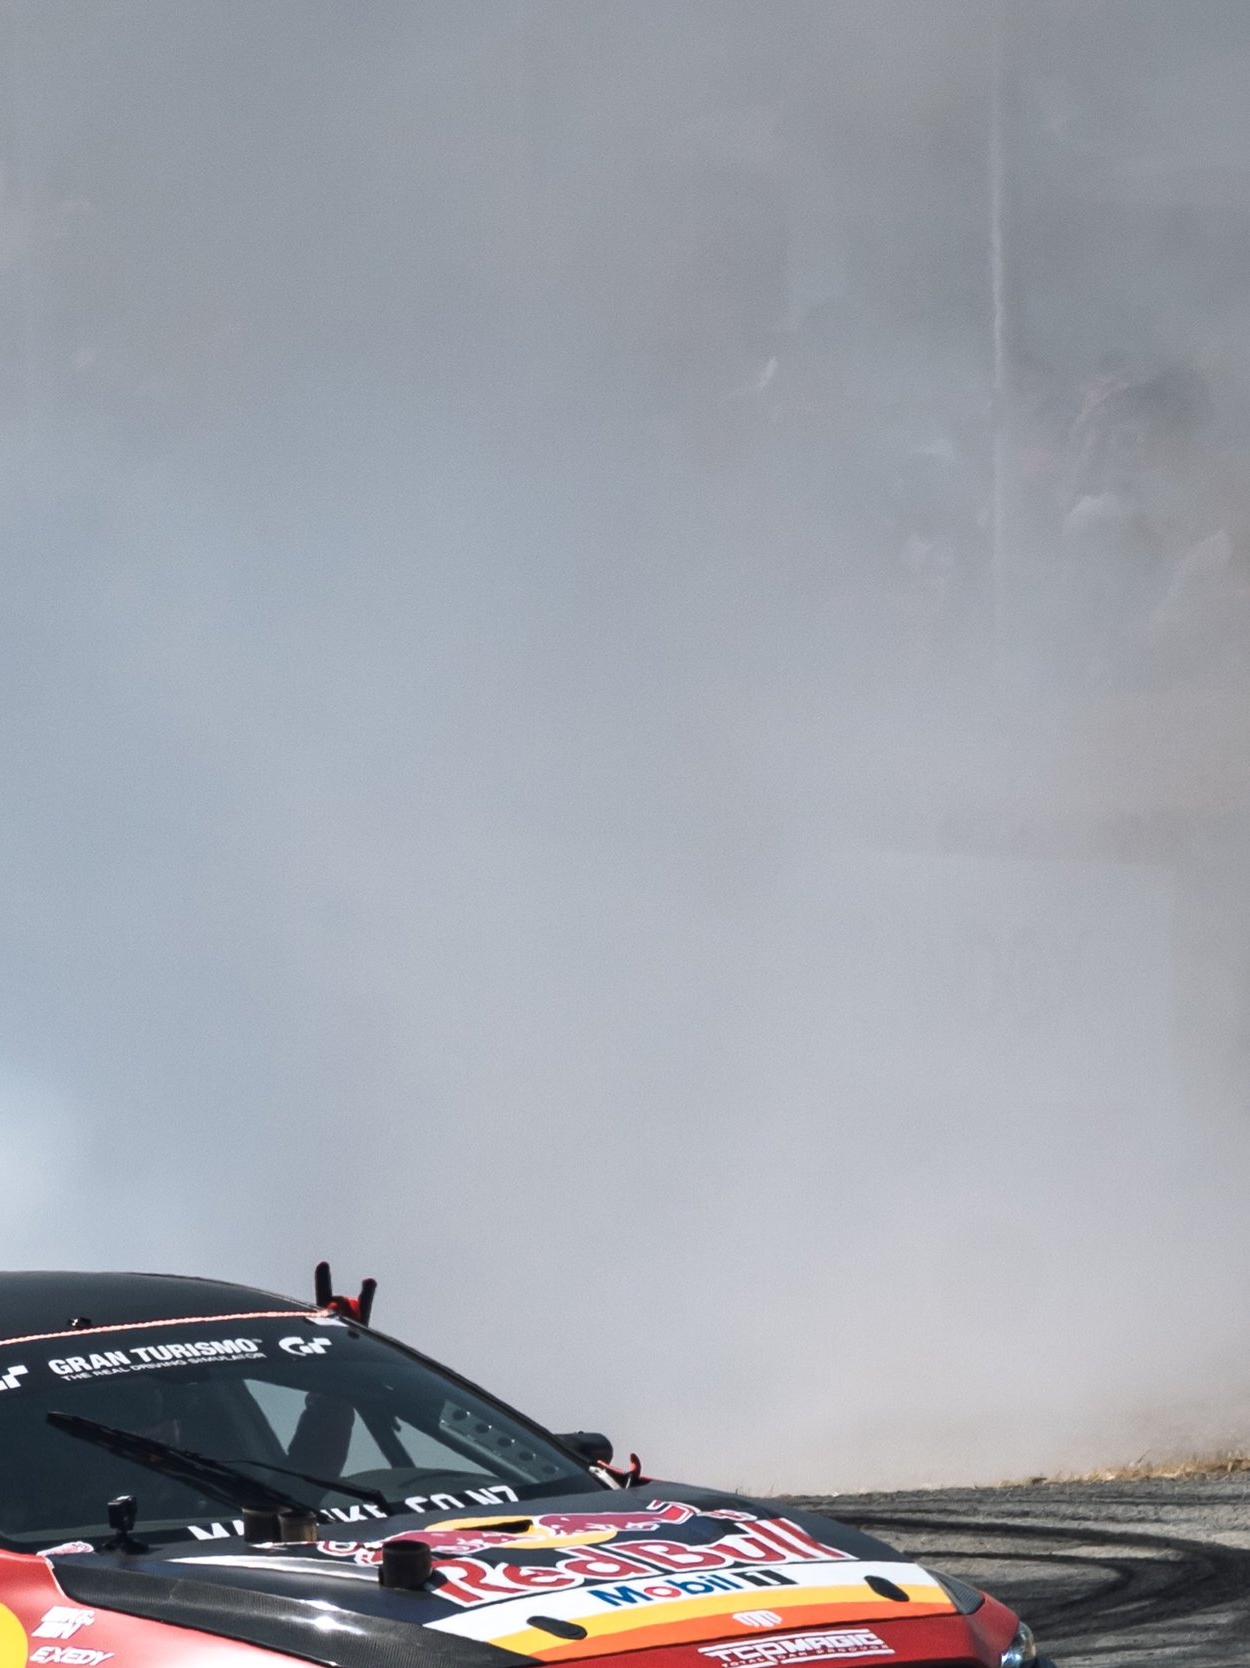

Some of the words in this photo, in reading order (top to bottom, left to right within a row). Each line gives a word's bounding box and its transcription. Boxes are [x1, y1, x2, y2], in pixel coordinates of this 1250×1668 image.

[48, 1352, 131, 1376] GRAN
[130, 1338, 259, 1363] TURISMO
[61, 1372, 92, 1382] THE
[94, 1366, 129, 1376] REAL
[187, 1352, 267, 1364] SIMULATOR
[610, 1517, 859, 1574] Bull
[588, 1571, 745, 1607] Mobil
[29, 1645, 115, 1666] EXEDY
